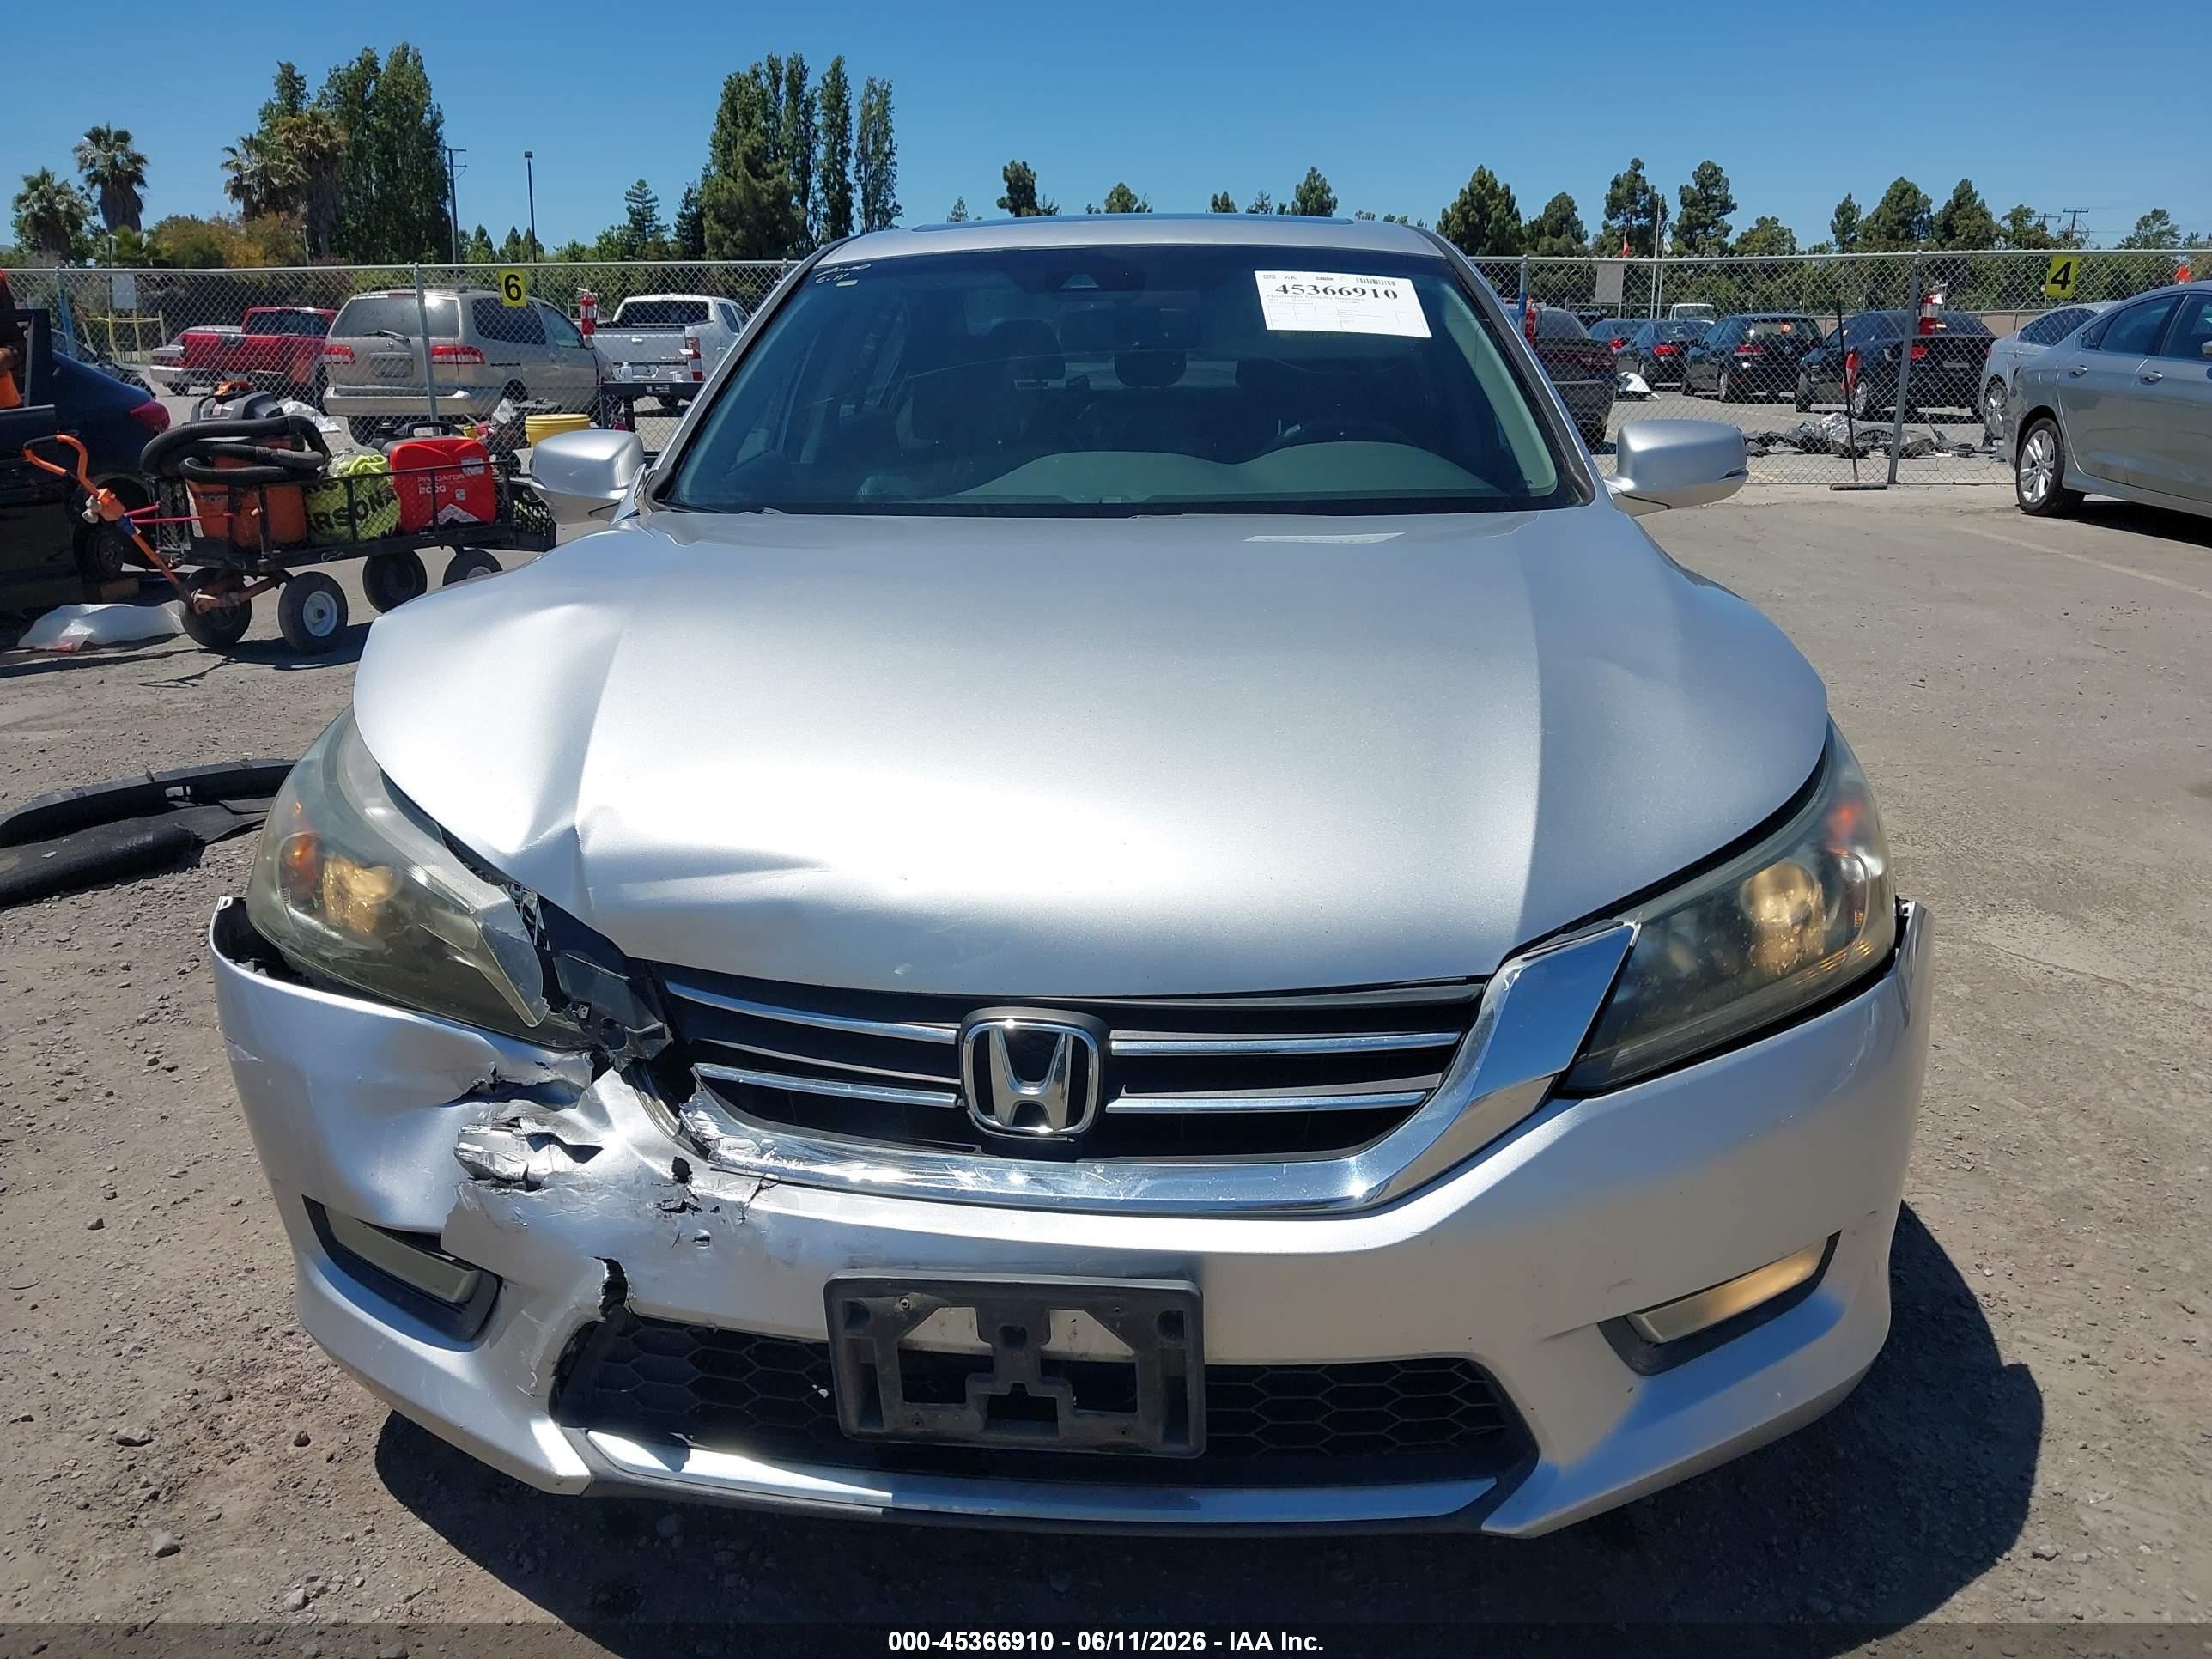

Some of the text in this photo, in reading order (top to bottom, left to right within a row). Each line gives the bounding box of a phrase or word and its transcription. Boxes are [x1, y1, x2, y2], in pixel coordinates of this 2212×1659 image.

[504, 273, 522, 301] 6
[2051, 261, 2072, 291] 4
[1275, 283, 1398, 300] 45366910
